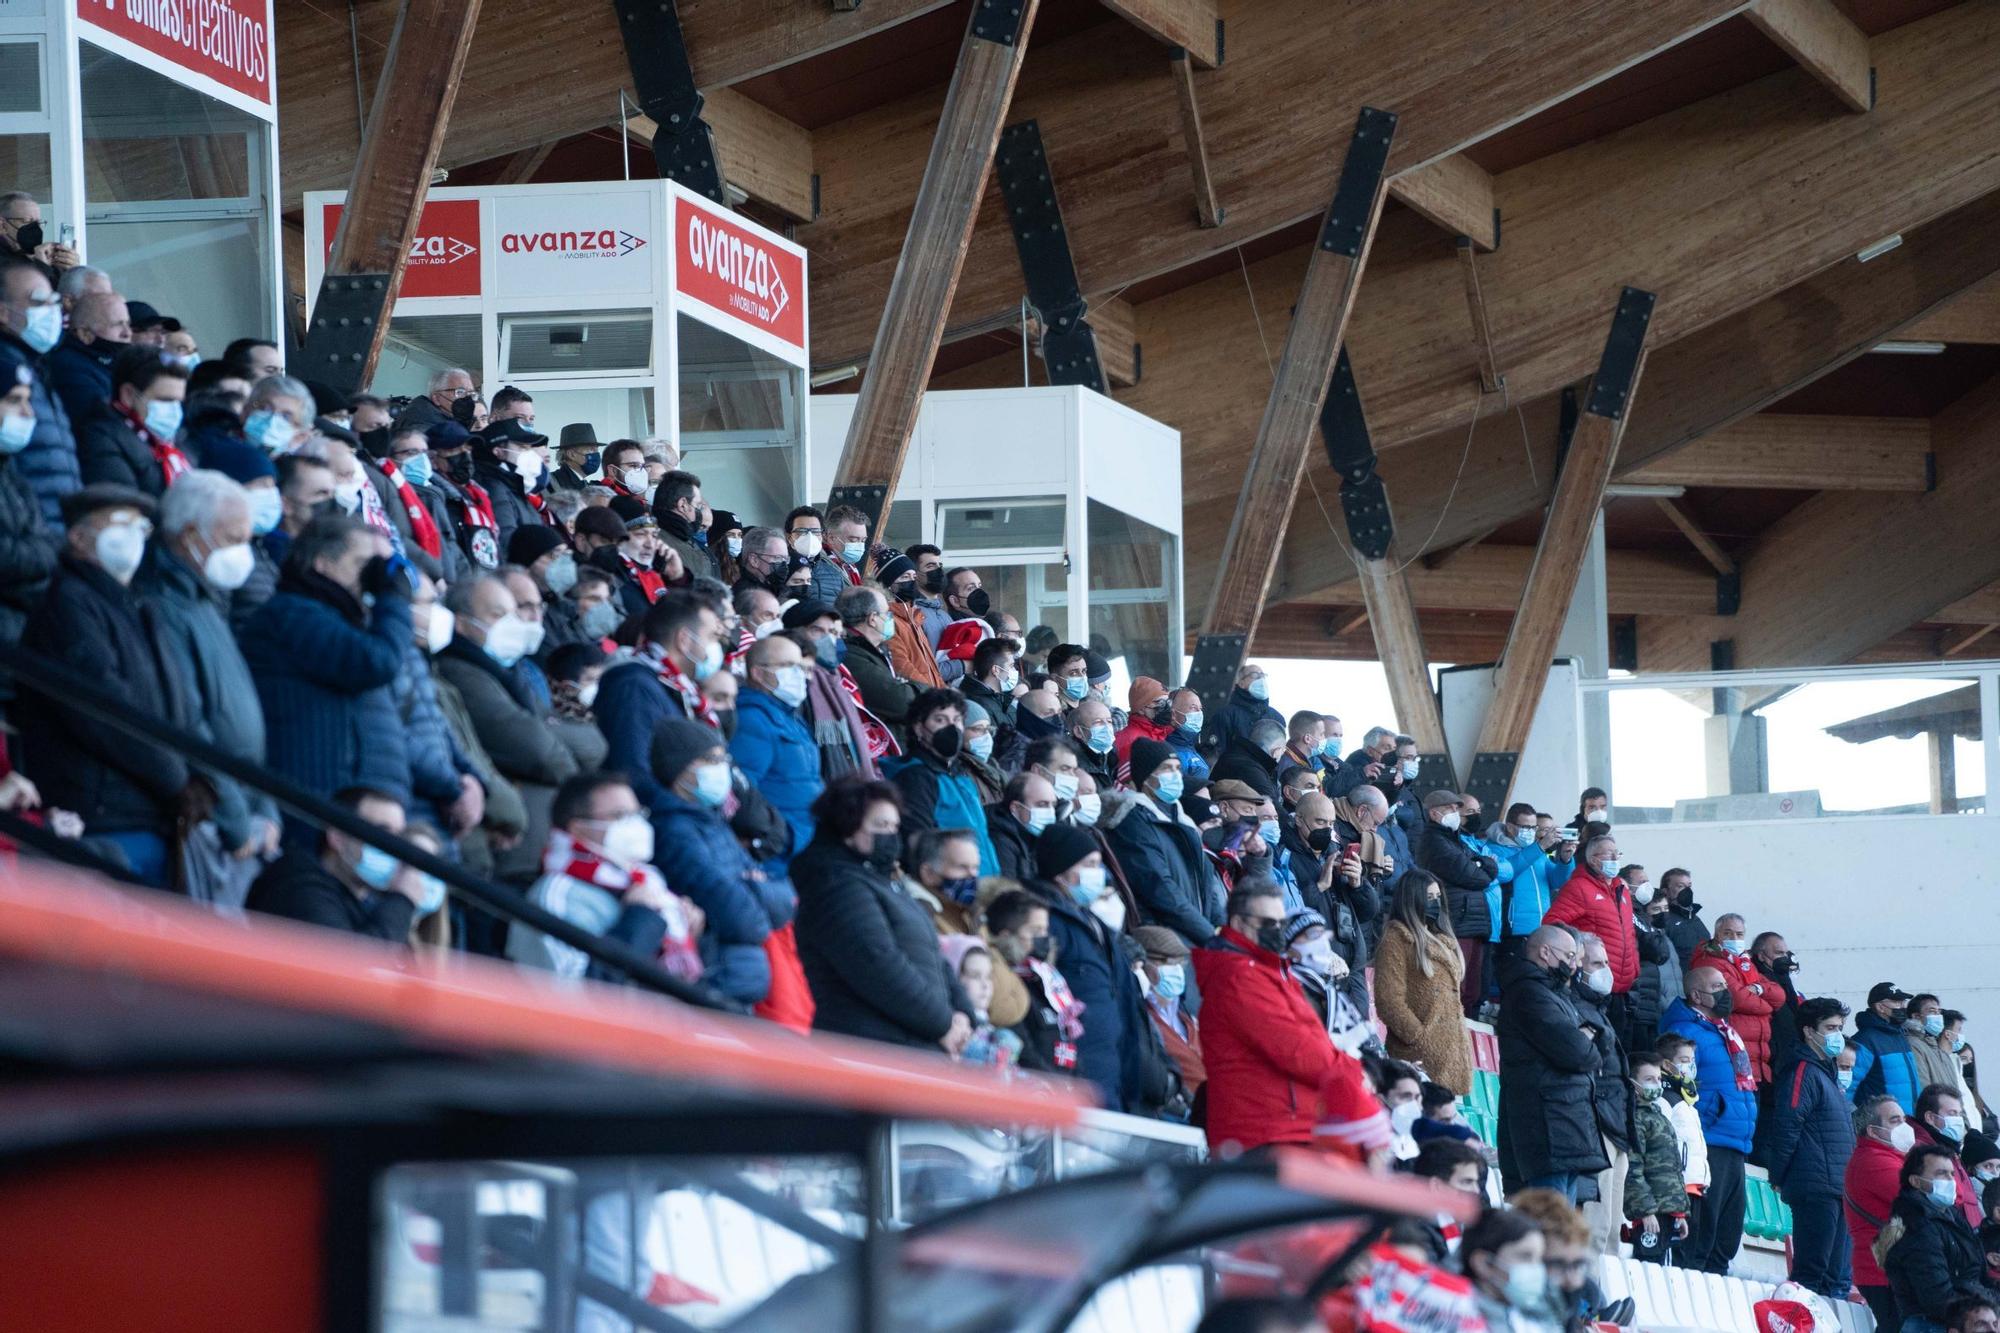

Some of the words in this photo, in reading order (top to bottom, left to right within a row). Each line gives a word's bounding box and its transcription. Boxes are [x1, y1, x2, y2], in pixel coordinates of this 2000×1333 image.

[501, 229, 617, 253] avanza
[430, 257, 446, 265] ADO
[689, 215, 769, 300] avanza
[734, 292, 758, 317] MOBILITY
[758, 303, 770, 322] ADO
